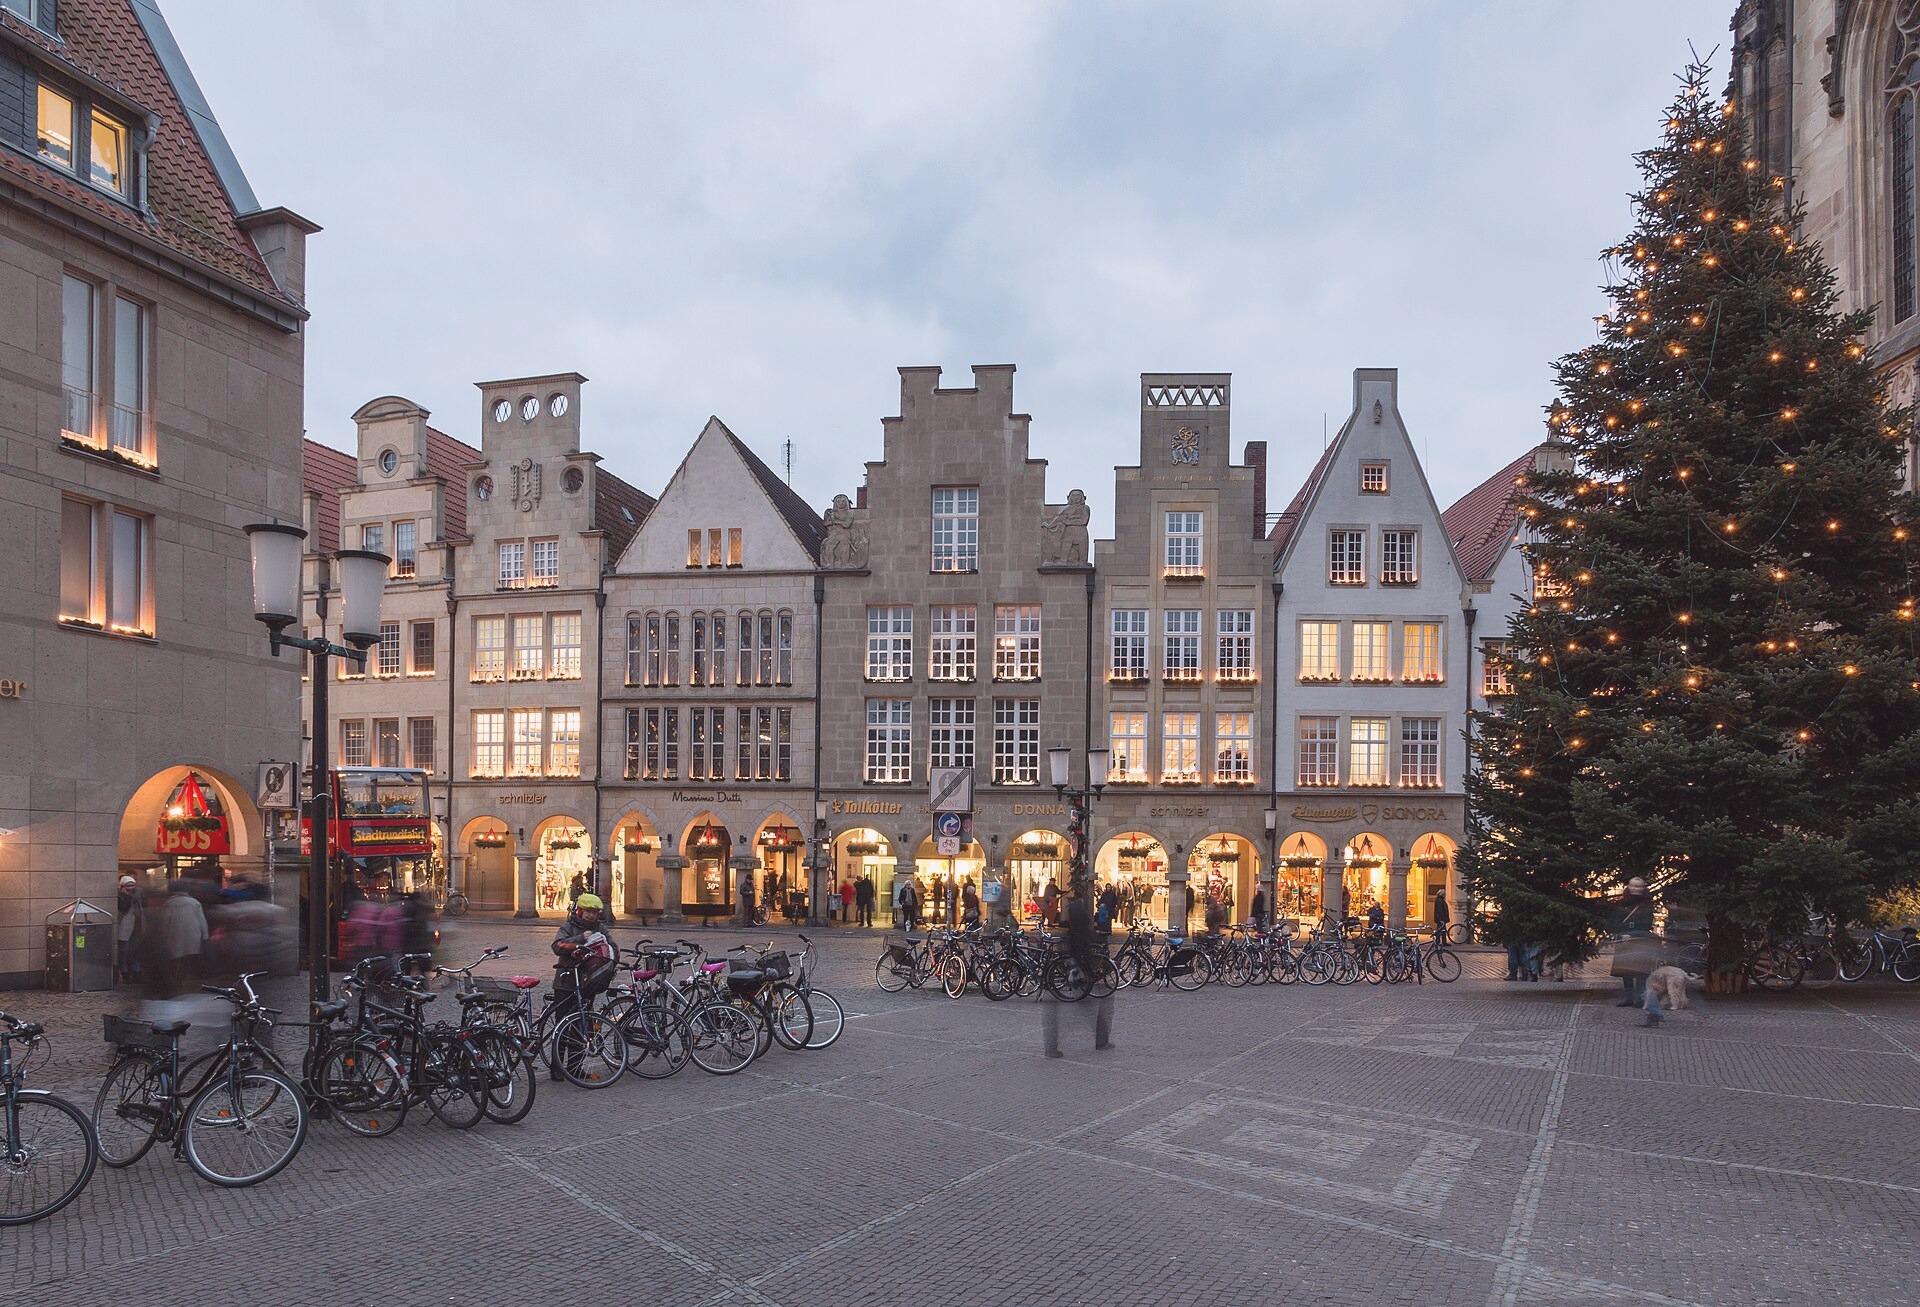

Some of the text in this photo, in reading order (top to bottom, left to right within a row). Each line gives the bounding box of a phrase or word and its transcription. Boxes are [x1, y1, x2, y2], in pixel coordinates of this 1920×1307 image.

[499, 793, 547, 805] schnitzler
[672, 792, 742, 803] Massimo Dutti
[845, 800, 902, 814] Tollkötter
[940, 801, 960, 809] ONE
[1014, 804, 1066, 816] DONNA
[1151, 806, 1210, 818] schnitzler
[1382, 808, 1447, 821] SIGNORA
[354, 828, 425, 842] Stadtrundfahrt
